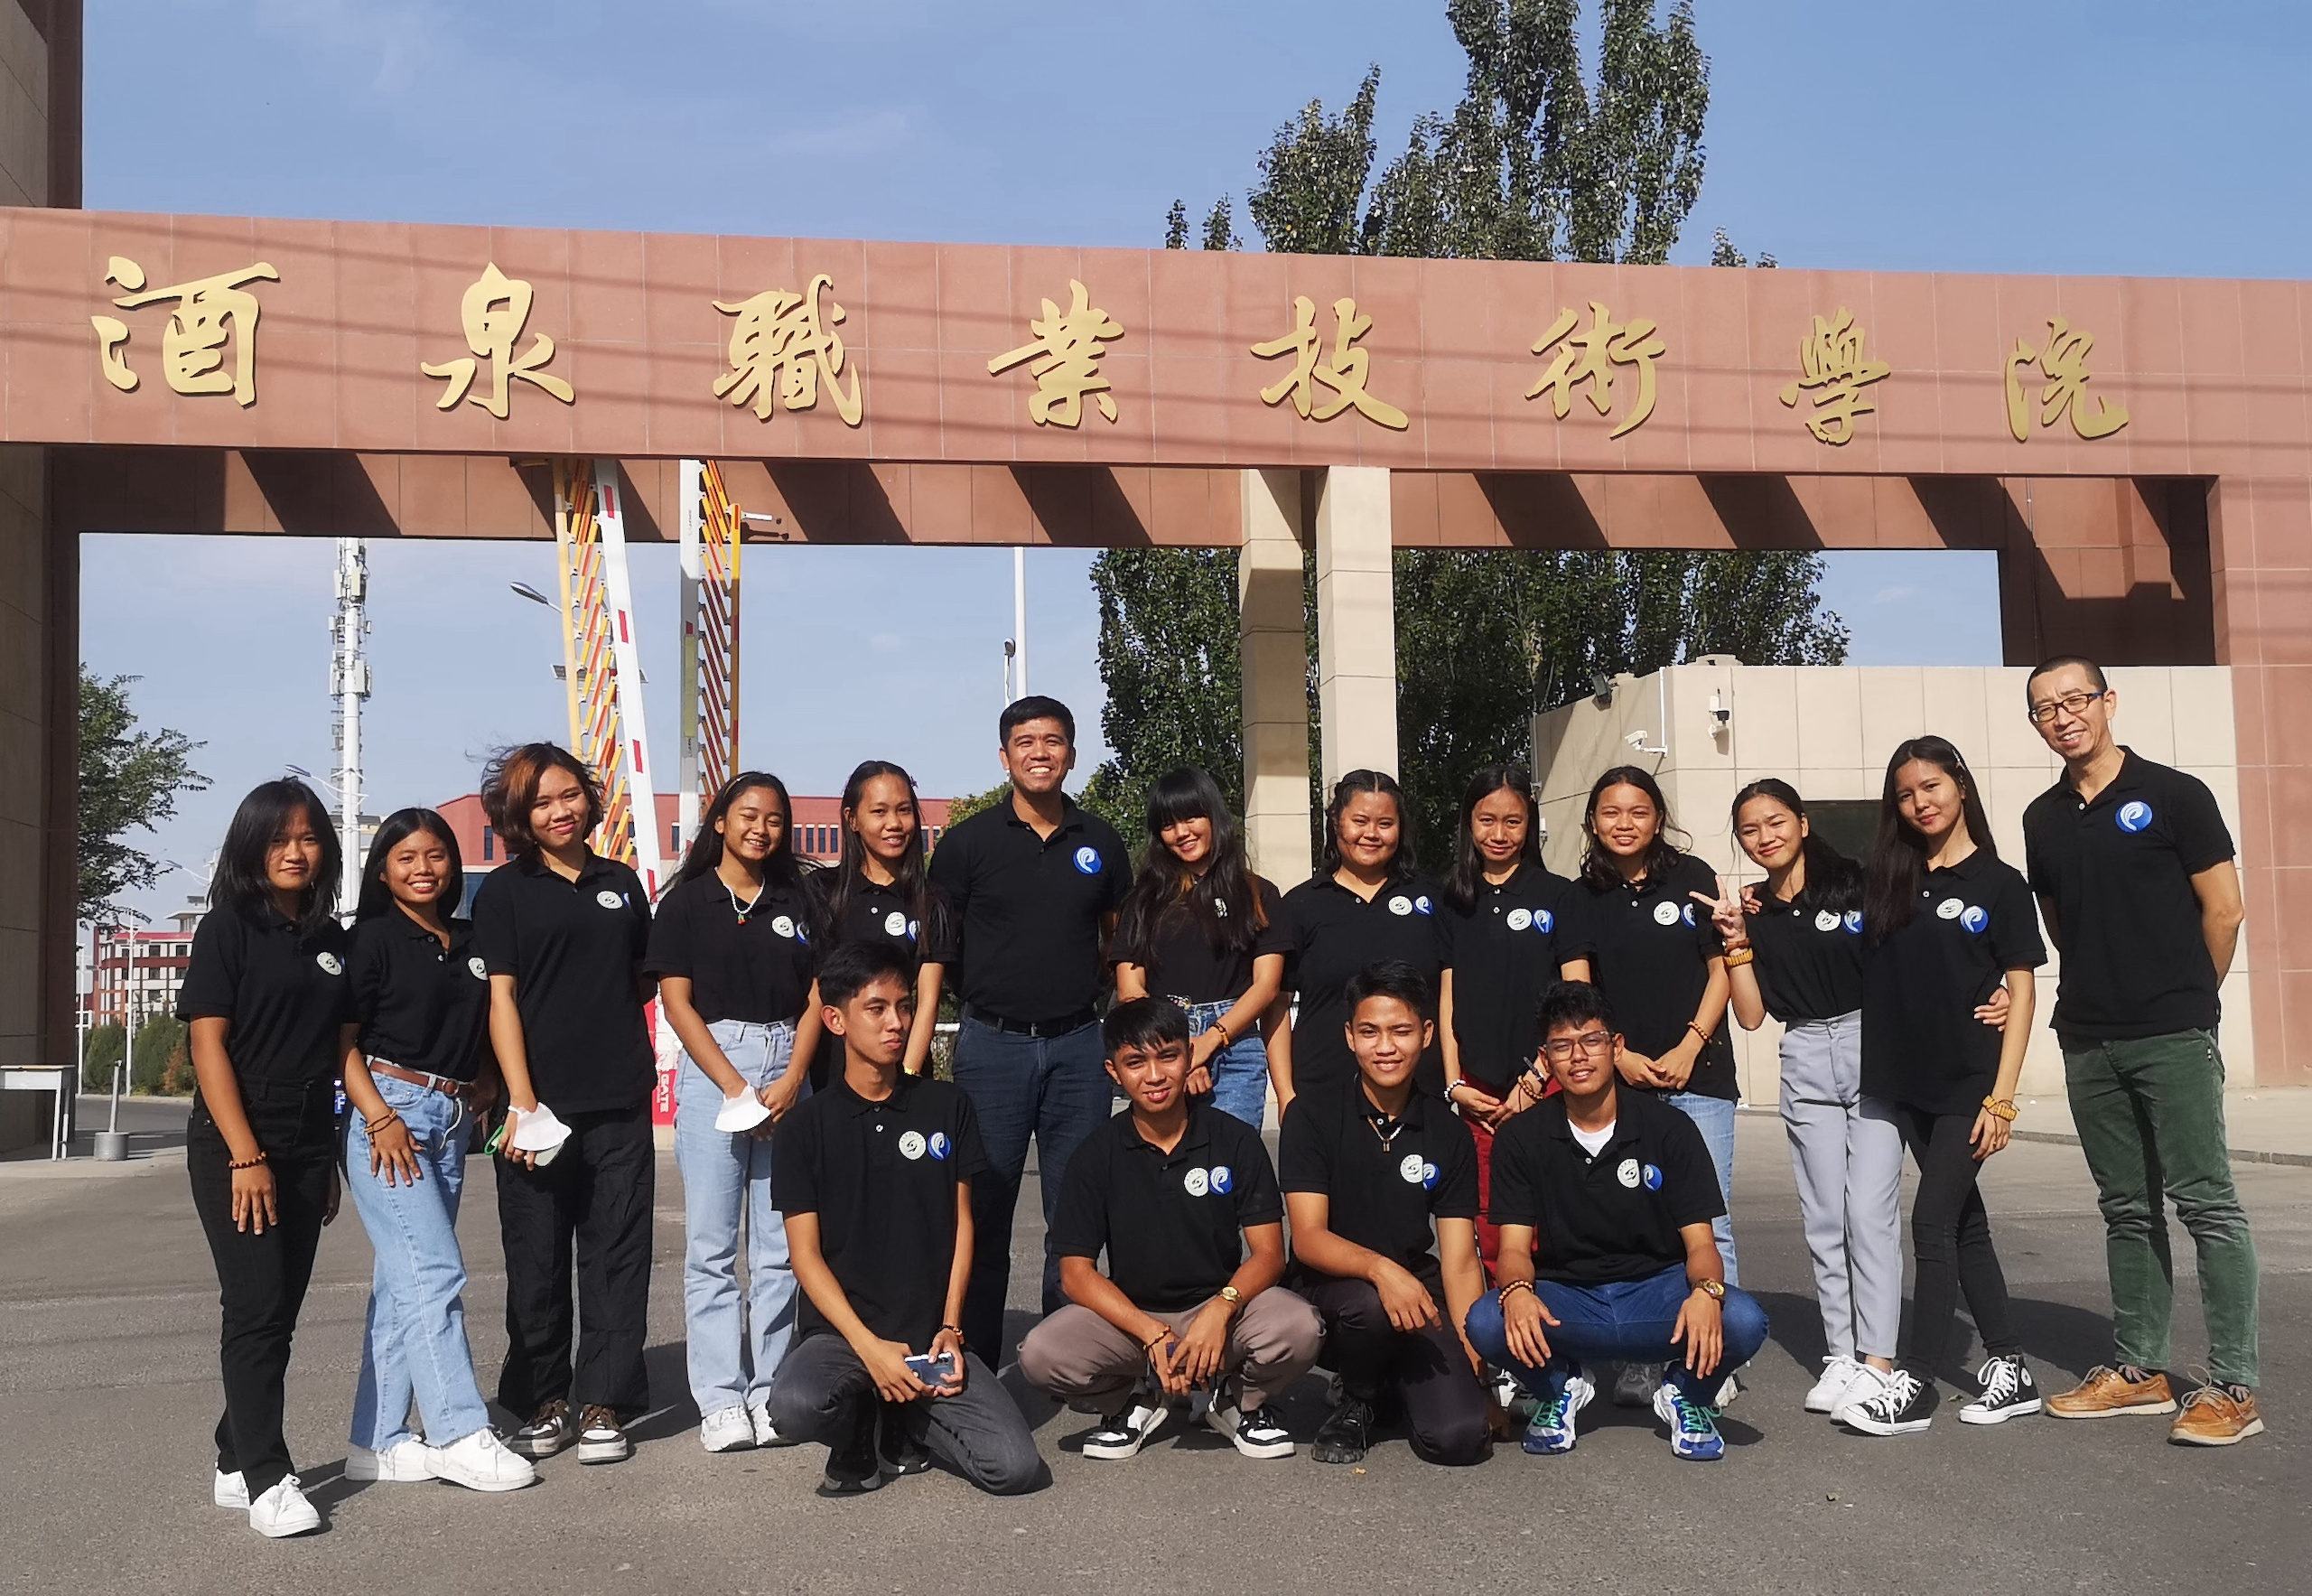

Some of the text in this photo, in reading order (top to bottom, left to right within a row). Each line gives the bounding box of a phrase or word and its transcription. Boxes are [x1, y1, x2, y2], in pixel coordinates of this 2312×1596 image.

[91, 255, 2130, 445] 酒泉職業技術學院
